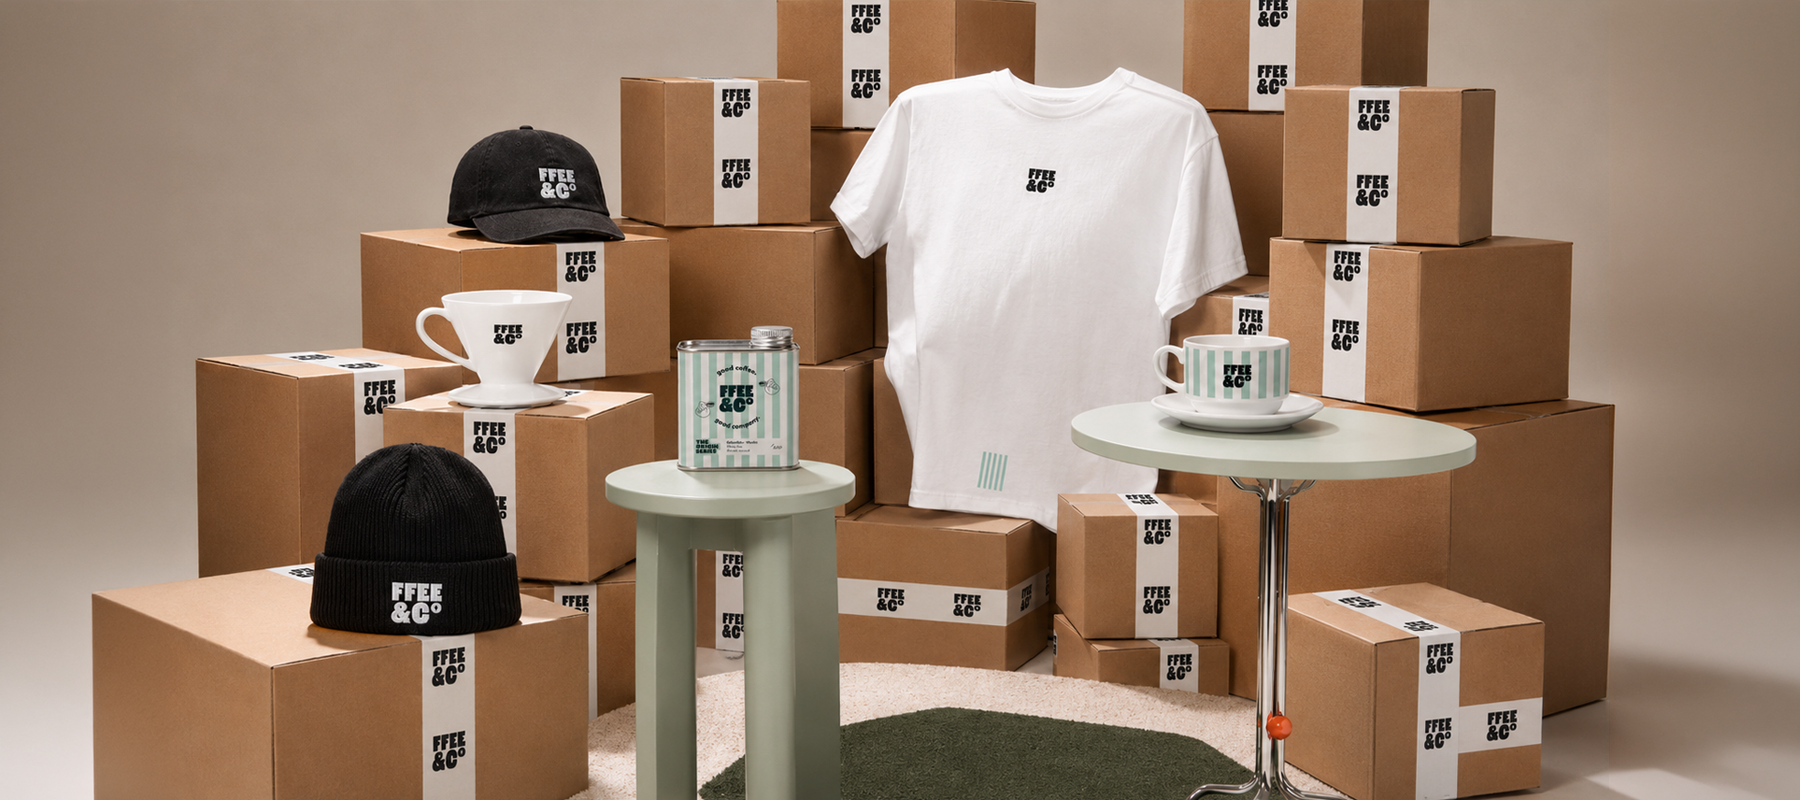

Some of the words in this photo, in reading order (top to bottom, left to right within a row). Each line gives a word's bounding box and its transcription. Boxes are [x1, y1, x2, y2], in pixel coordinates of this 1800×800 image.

[852, 5, 880, 17] FFEE
[1259, 0, 1288, 11] FFEE
[852, 69, 880, 82] FFEE
[1258, 65, 1287, 78] FFEE
[722, 89, 750, 101] FFEE
[1359, 100, 1390, 113] FFEE
[722, 159, 750, 172] FFEE
[539, 168, 575, 182] FFEE
[1029, 169, 1055, 181] FFEE
[1357, 175, 1388, 189] FFEE
[566, 251, 596, 265] FFEE
[1334, 251, 1361, 265] FFEE
[1239, 309, 1263, 323] FFEE
[494, 325, 522, 333] FFEE
[567, 322, 597, 337] FFEE
[1333, 319, 1359, 334] FFEE
[716, 365, 733, 376] good
[1224, 365, 1252, 376] FFEE
[364, 380, 395, 396] FFEE
[720, 385, 753, 397] FFEE
[474, 422, 505, 436] FFEE
[714, 418, 731, 429] good
[1145, 519, 1171, 530] FFEE
[392, 582, 442, 601] FFEE
[878, 588, 904, 599] FFEE
[1144, 586, 1170, 598] FFEE
[562, 595, 589, 607] FFEE
[954, 594, 981, 605] FFEE
[433, 647, 465, 666] FFEE
[1427, 643, 1453, 658] FFEE
[1168, 654, 1192, 666] FFEE
[1488, 710, 1518, 727] FFEE
[1425, 718, 1451, 733] FFEE
[433, 731, 465, 752] FFEE
